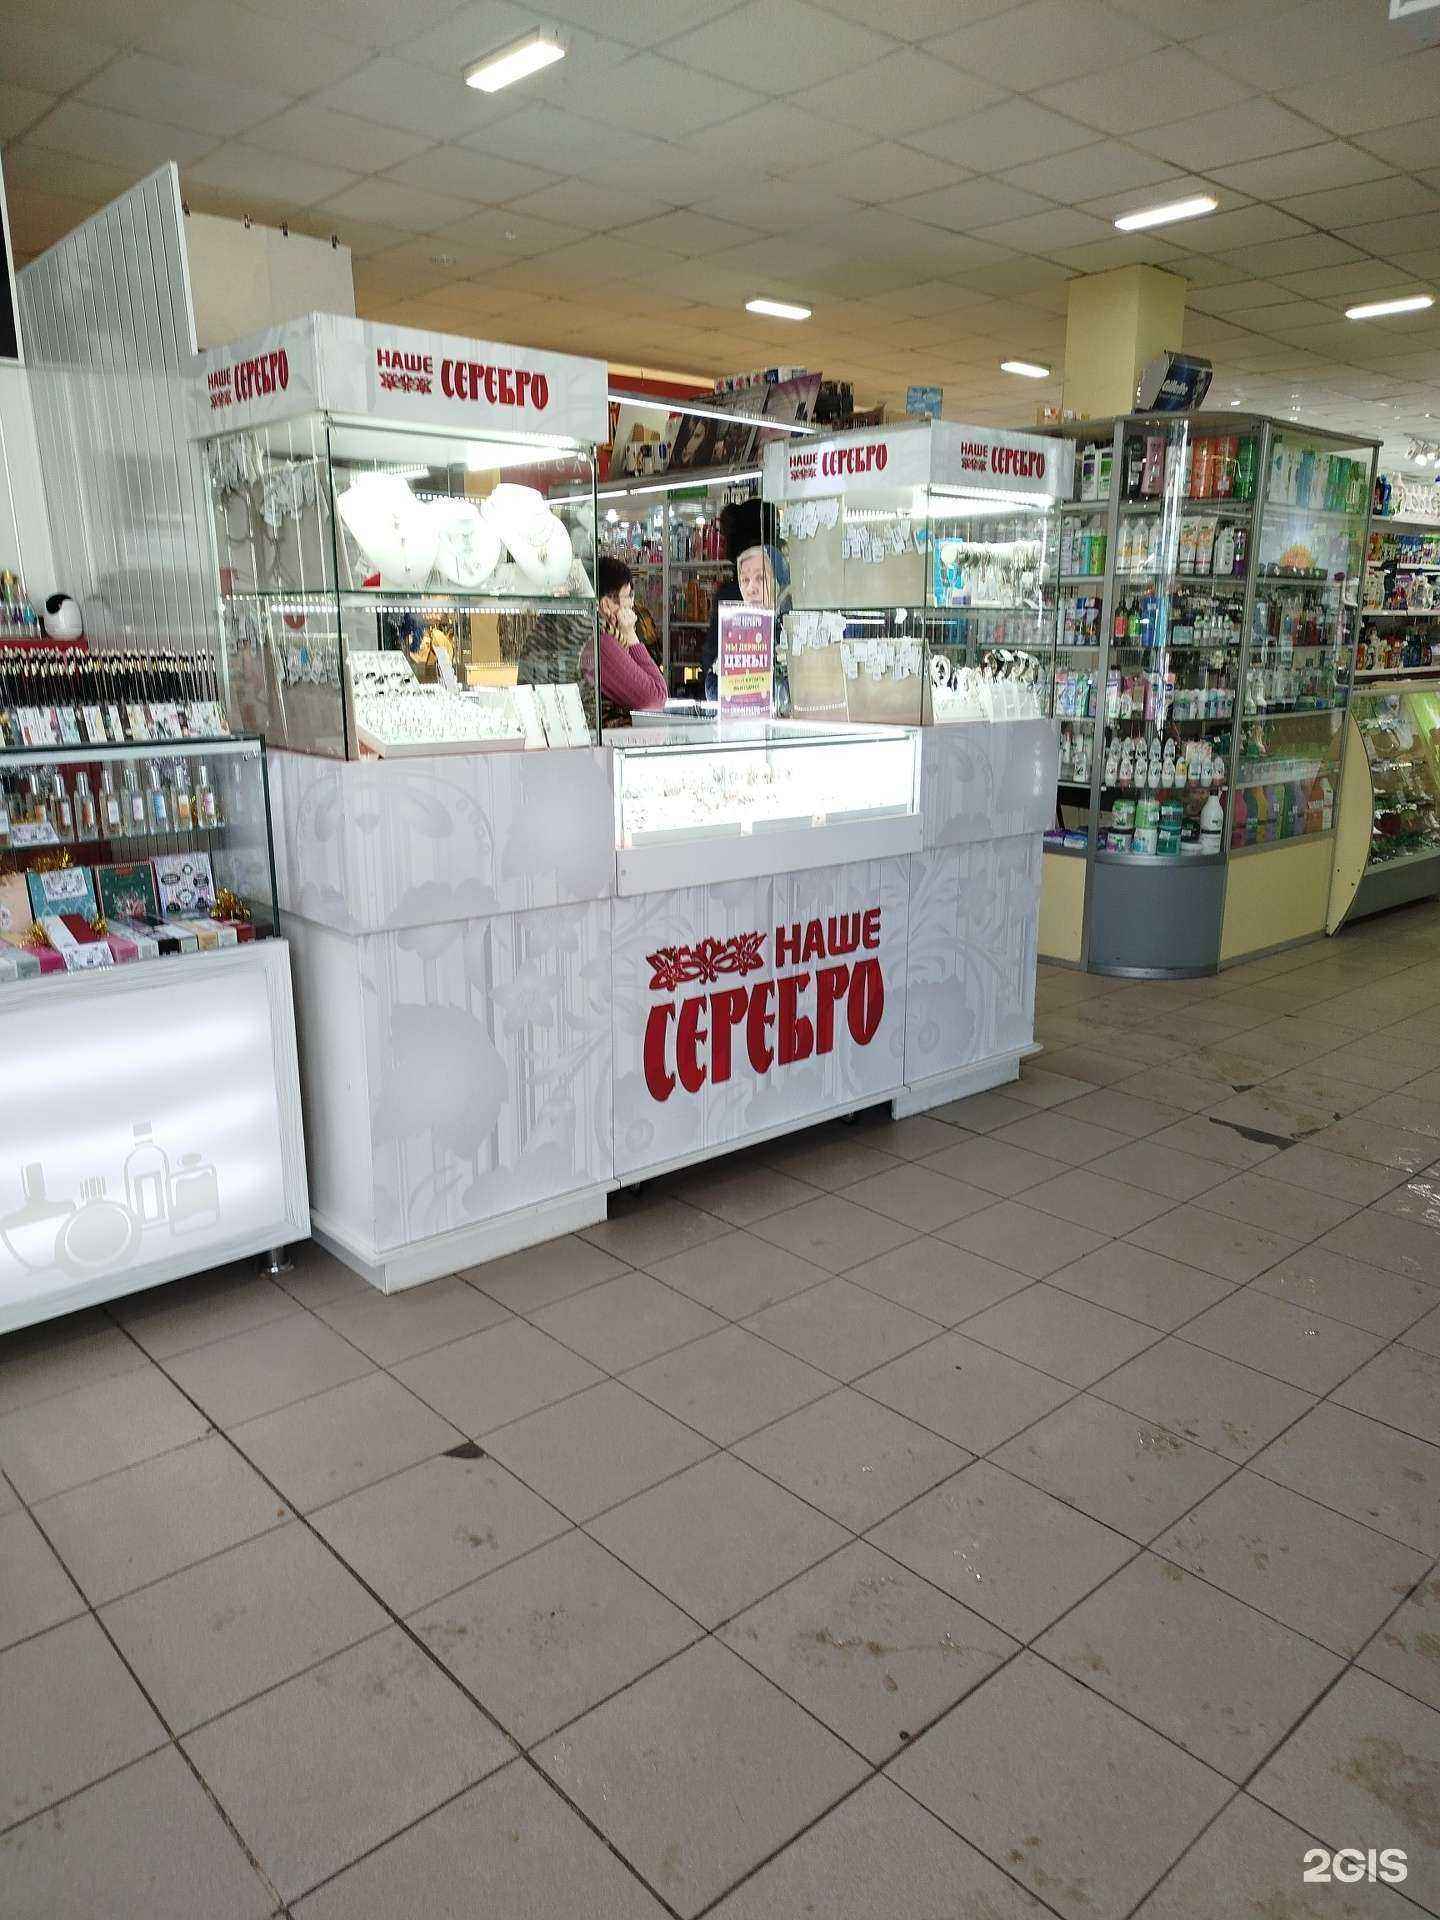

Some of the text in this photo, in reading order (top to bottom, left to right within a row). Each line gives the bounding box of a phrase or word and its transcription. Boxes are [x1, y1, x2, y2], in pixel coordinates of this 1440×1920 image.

[207, 347, 289, 403] НАШЕ СЕРЕБРО
[376, 347, 550, 412] НАШЕ СЕРЕБРО
[789, 442, 888, 477] НАШЕ СЕРЕБРО
[960, 441, 1046, 480] НАШЕ СЕРЕБРО
[724, 653, 768, 670] ЦЕНЫ!
[775, 906, 882, 968] НАШЕ
[643, 956, 885, 1102] СЕРЕБРО
